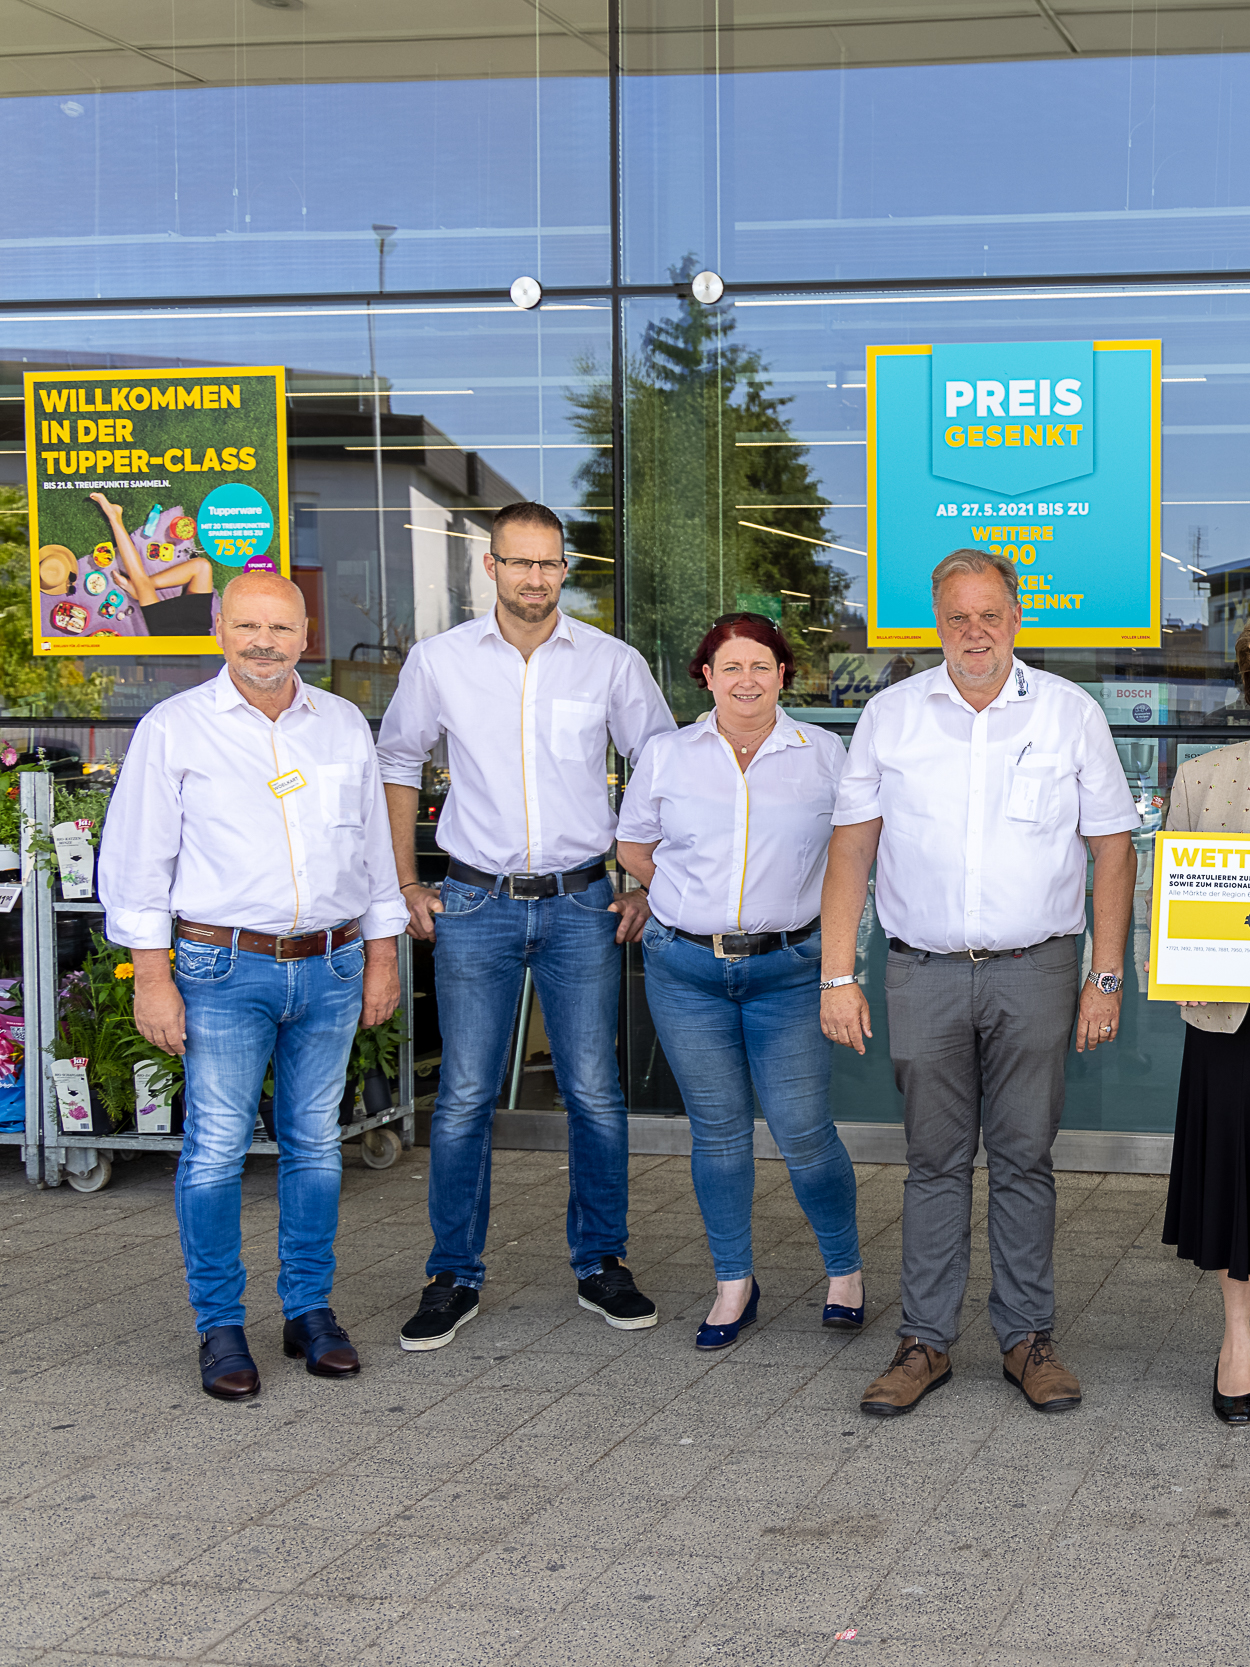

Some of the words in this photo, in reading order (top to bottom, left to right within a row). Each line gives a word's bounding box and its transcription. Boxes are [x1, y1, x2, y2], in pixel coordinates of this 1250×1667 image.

[39, 384, 241, 413] WILLKOMMEN
[945, 378, 1082, 418] PREIS
[41, 420, 70, 444] IN
[77, 418, 134, 443] DER
[944, 423, 1083, 448] GESENKT
[41, 446, 257, 475] TUPPER-CLASS
[43, 481, 56, 490] BIS
[57, 481, 74, 489] 21.8.
[75, 480, 129, 489] TREUEPUNKTE
[130, 479, 171, 488] SAMMELN.
[208, 506, 262, 517] Tupperware
[936, 503, 958, 516] AB
[961, 502, 1034, 516] 27.5.2021
[1038, 502, 1064, 516] BIS
[1067, 502, 1089, 516] ZU
[971, 525, 1053, 541] WEITERE
[1017, 594, 1084, 609] SENKT
[1116, 689, 1152, 698] BOSCH
[78, 818, 92, 827] ja!
[1185, 873, 1237, 881] GRATULIEREN
[1222, 891, 1246, 899] Region
[73, 1056, 86, 1065] ja!
